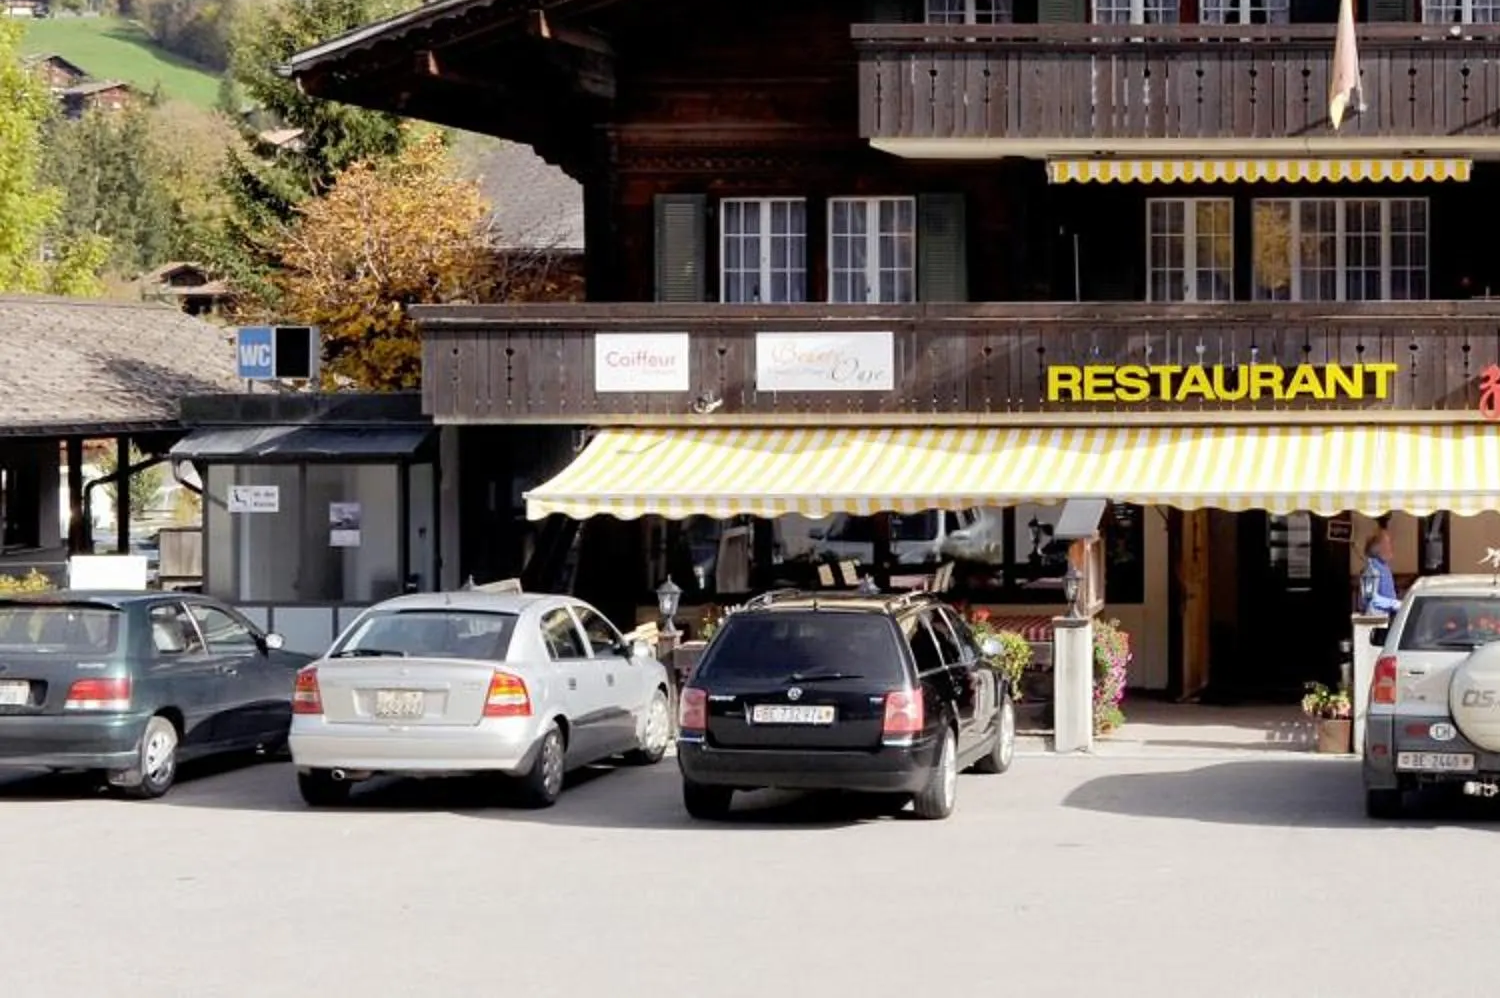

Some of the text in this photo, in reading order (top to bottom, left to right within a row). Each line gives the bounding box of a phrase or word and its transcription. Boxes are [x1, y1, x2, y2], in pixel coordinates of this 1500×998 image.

[240, 344, 271, 367] WC
[604, 349, 677, 368] Coiffeur
[1047, 363, 1397, 402] RESTAURANT
